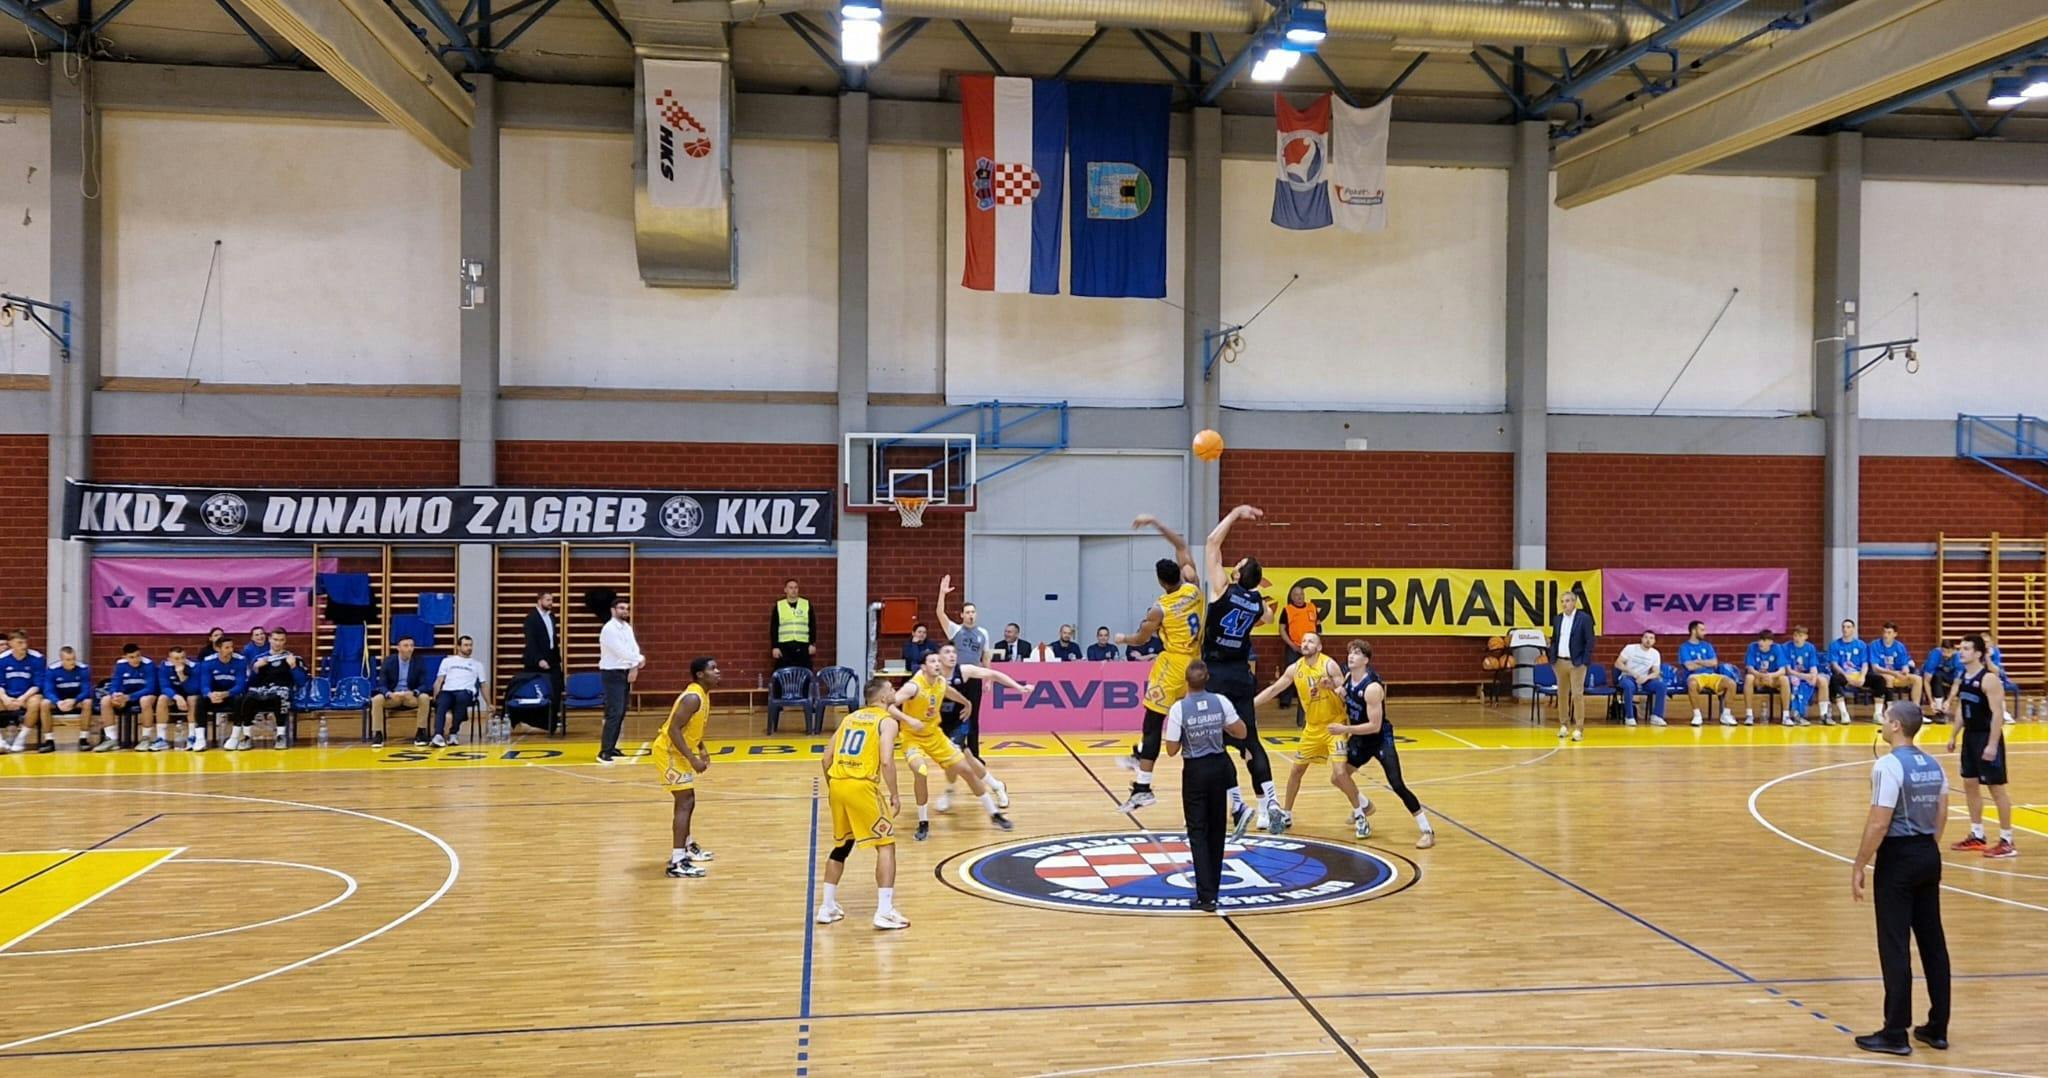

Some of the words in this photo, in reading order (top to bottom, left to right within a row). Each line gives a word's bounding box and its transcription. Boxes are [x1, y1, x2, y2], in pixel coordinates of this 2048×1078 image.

[660, 125, 674, 182] HKS
[79, 491, 188, 532] KKDZ
[262, 497, 453, 534] DINAMO
[465, 496, 648, 534] ZAGREB
[715, 498, 820, 534] KKDZ
[1643, 593, 1781, 612] FAVBET
[1220, 608, 1256, 637] 47
[993, 680, 1148, 710] FAVB
[840, 729, 866, 755] 10
[1011, 836, 1149, 859] DINAMO
